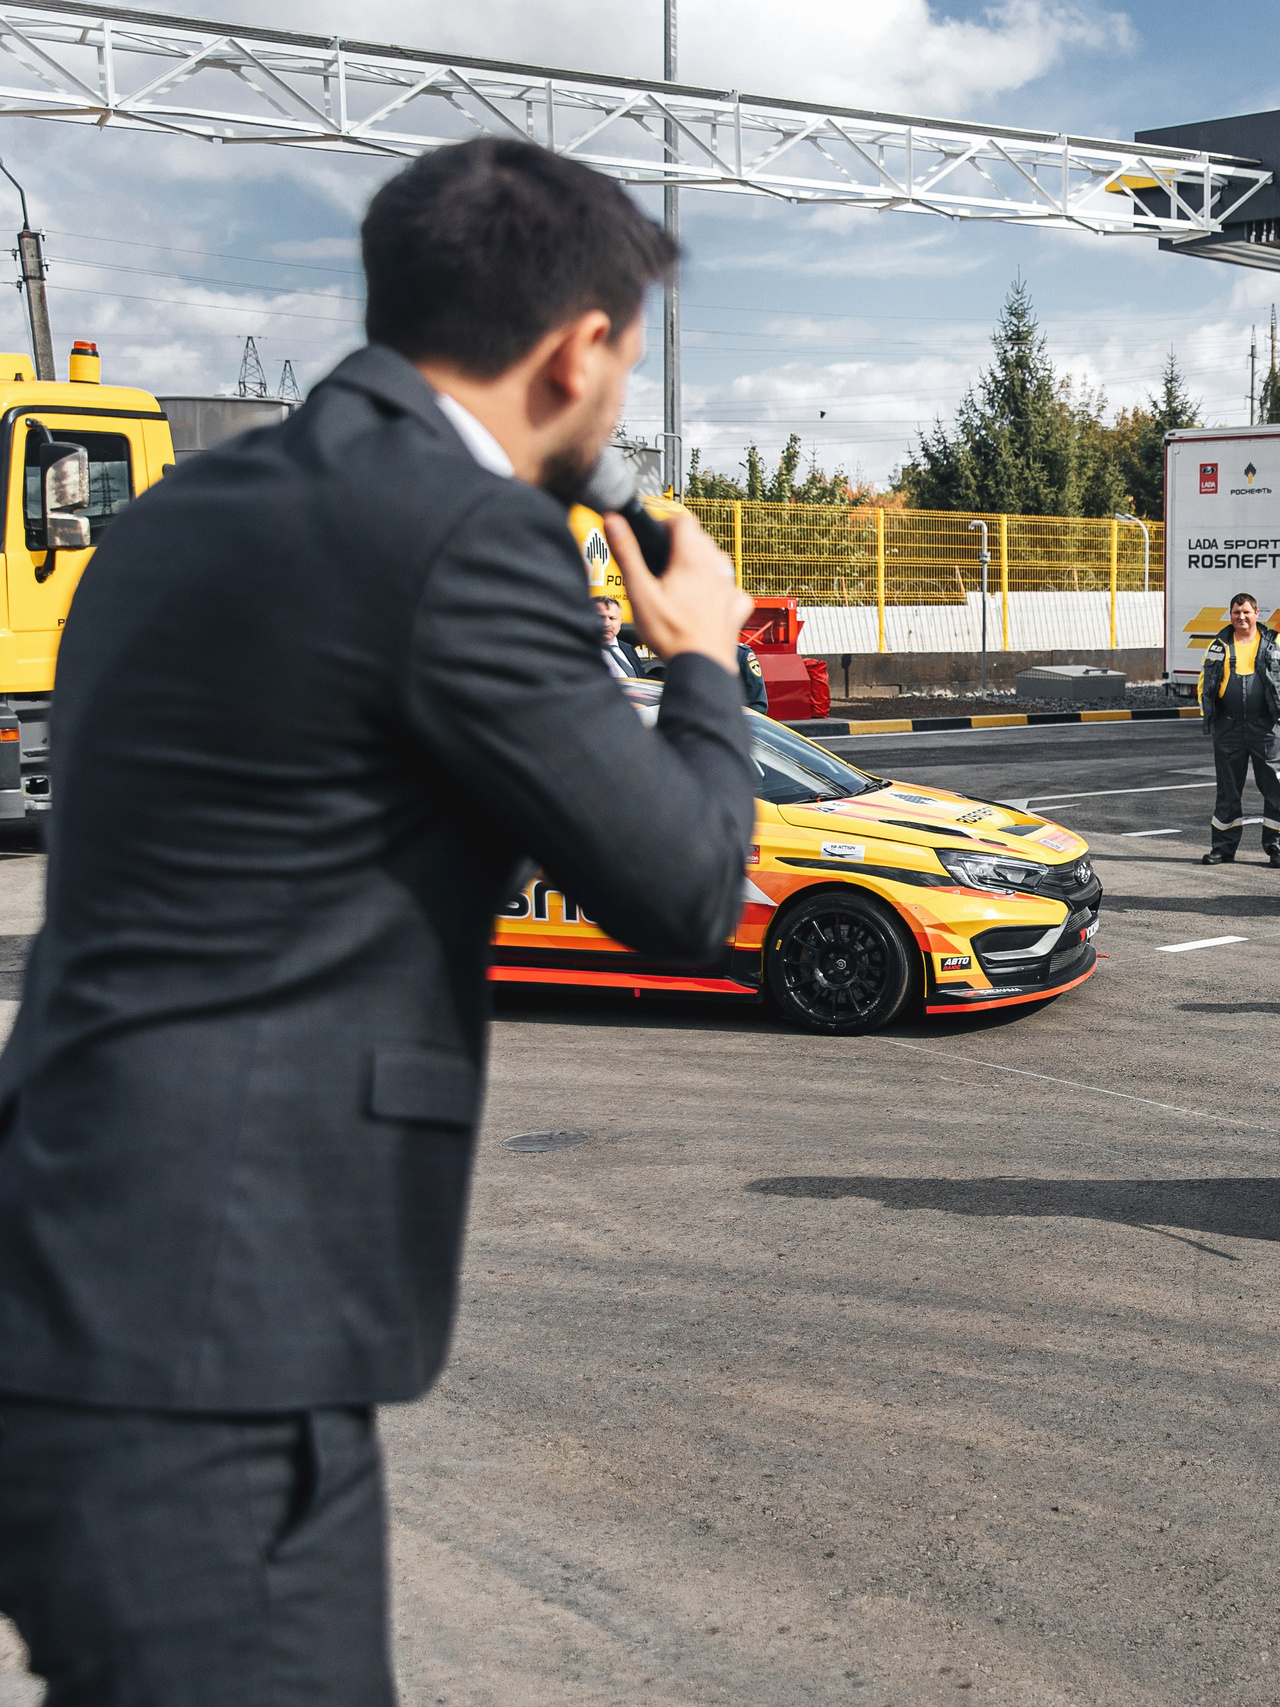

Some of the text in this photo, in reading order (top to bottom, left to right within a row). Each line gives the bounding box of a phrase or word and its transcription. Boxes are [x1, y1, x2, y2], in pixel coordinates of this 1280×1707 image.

[1230, 487, 1272, 496] РОСНЕФТЬ
[1188, 539, 1280, 550] LADA SPORT
[1188, 553, 1280, 569] ROSNEFT
[944, 957, 970, 966] АВТО
